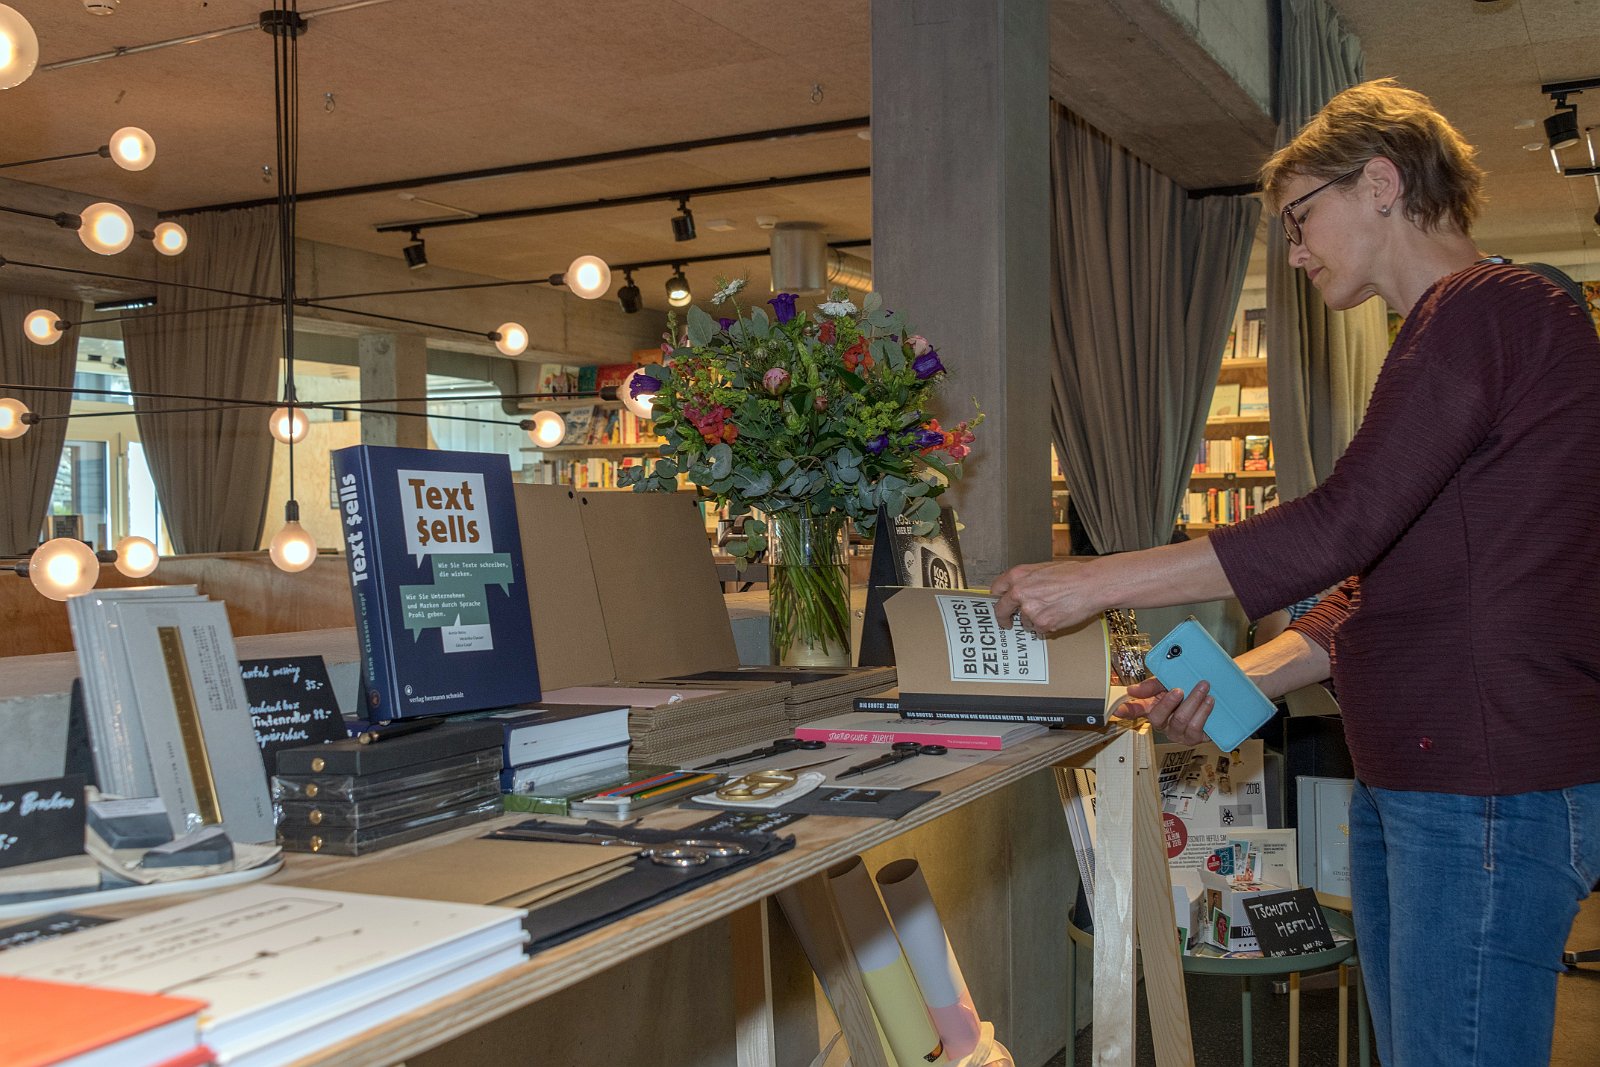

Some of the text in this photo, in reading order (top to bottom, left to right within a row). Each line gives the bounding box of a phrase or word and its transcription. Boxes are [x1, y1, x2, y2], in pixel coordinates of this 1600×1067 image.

[408, 478, 474, 511] Text
[347, 531, 368, 587] Text
[951, 599, 978, 674] BIG SHOTS!
[970, 600, 999, 675] ZEICHNEN
[1001, 649, 1009, 660] DIE
[1014, 628, 1029, 675] SELWYN
[1002, 662, 1010, 675] WIE
[1246, 782, 1261, 795] 2018
